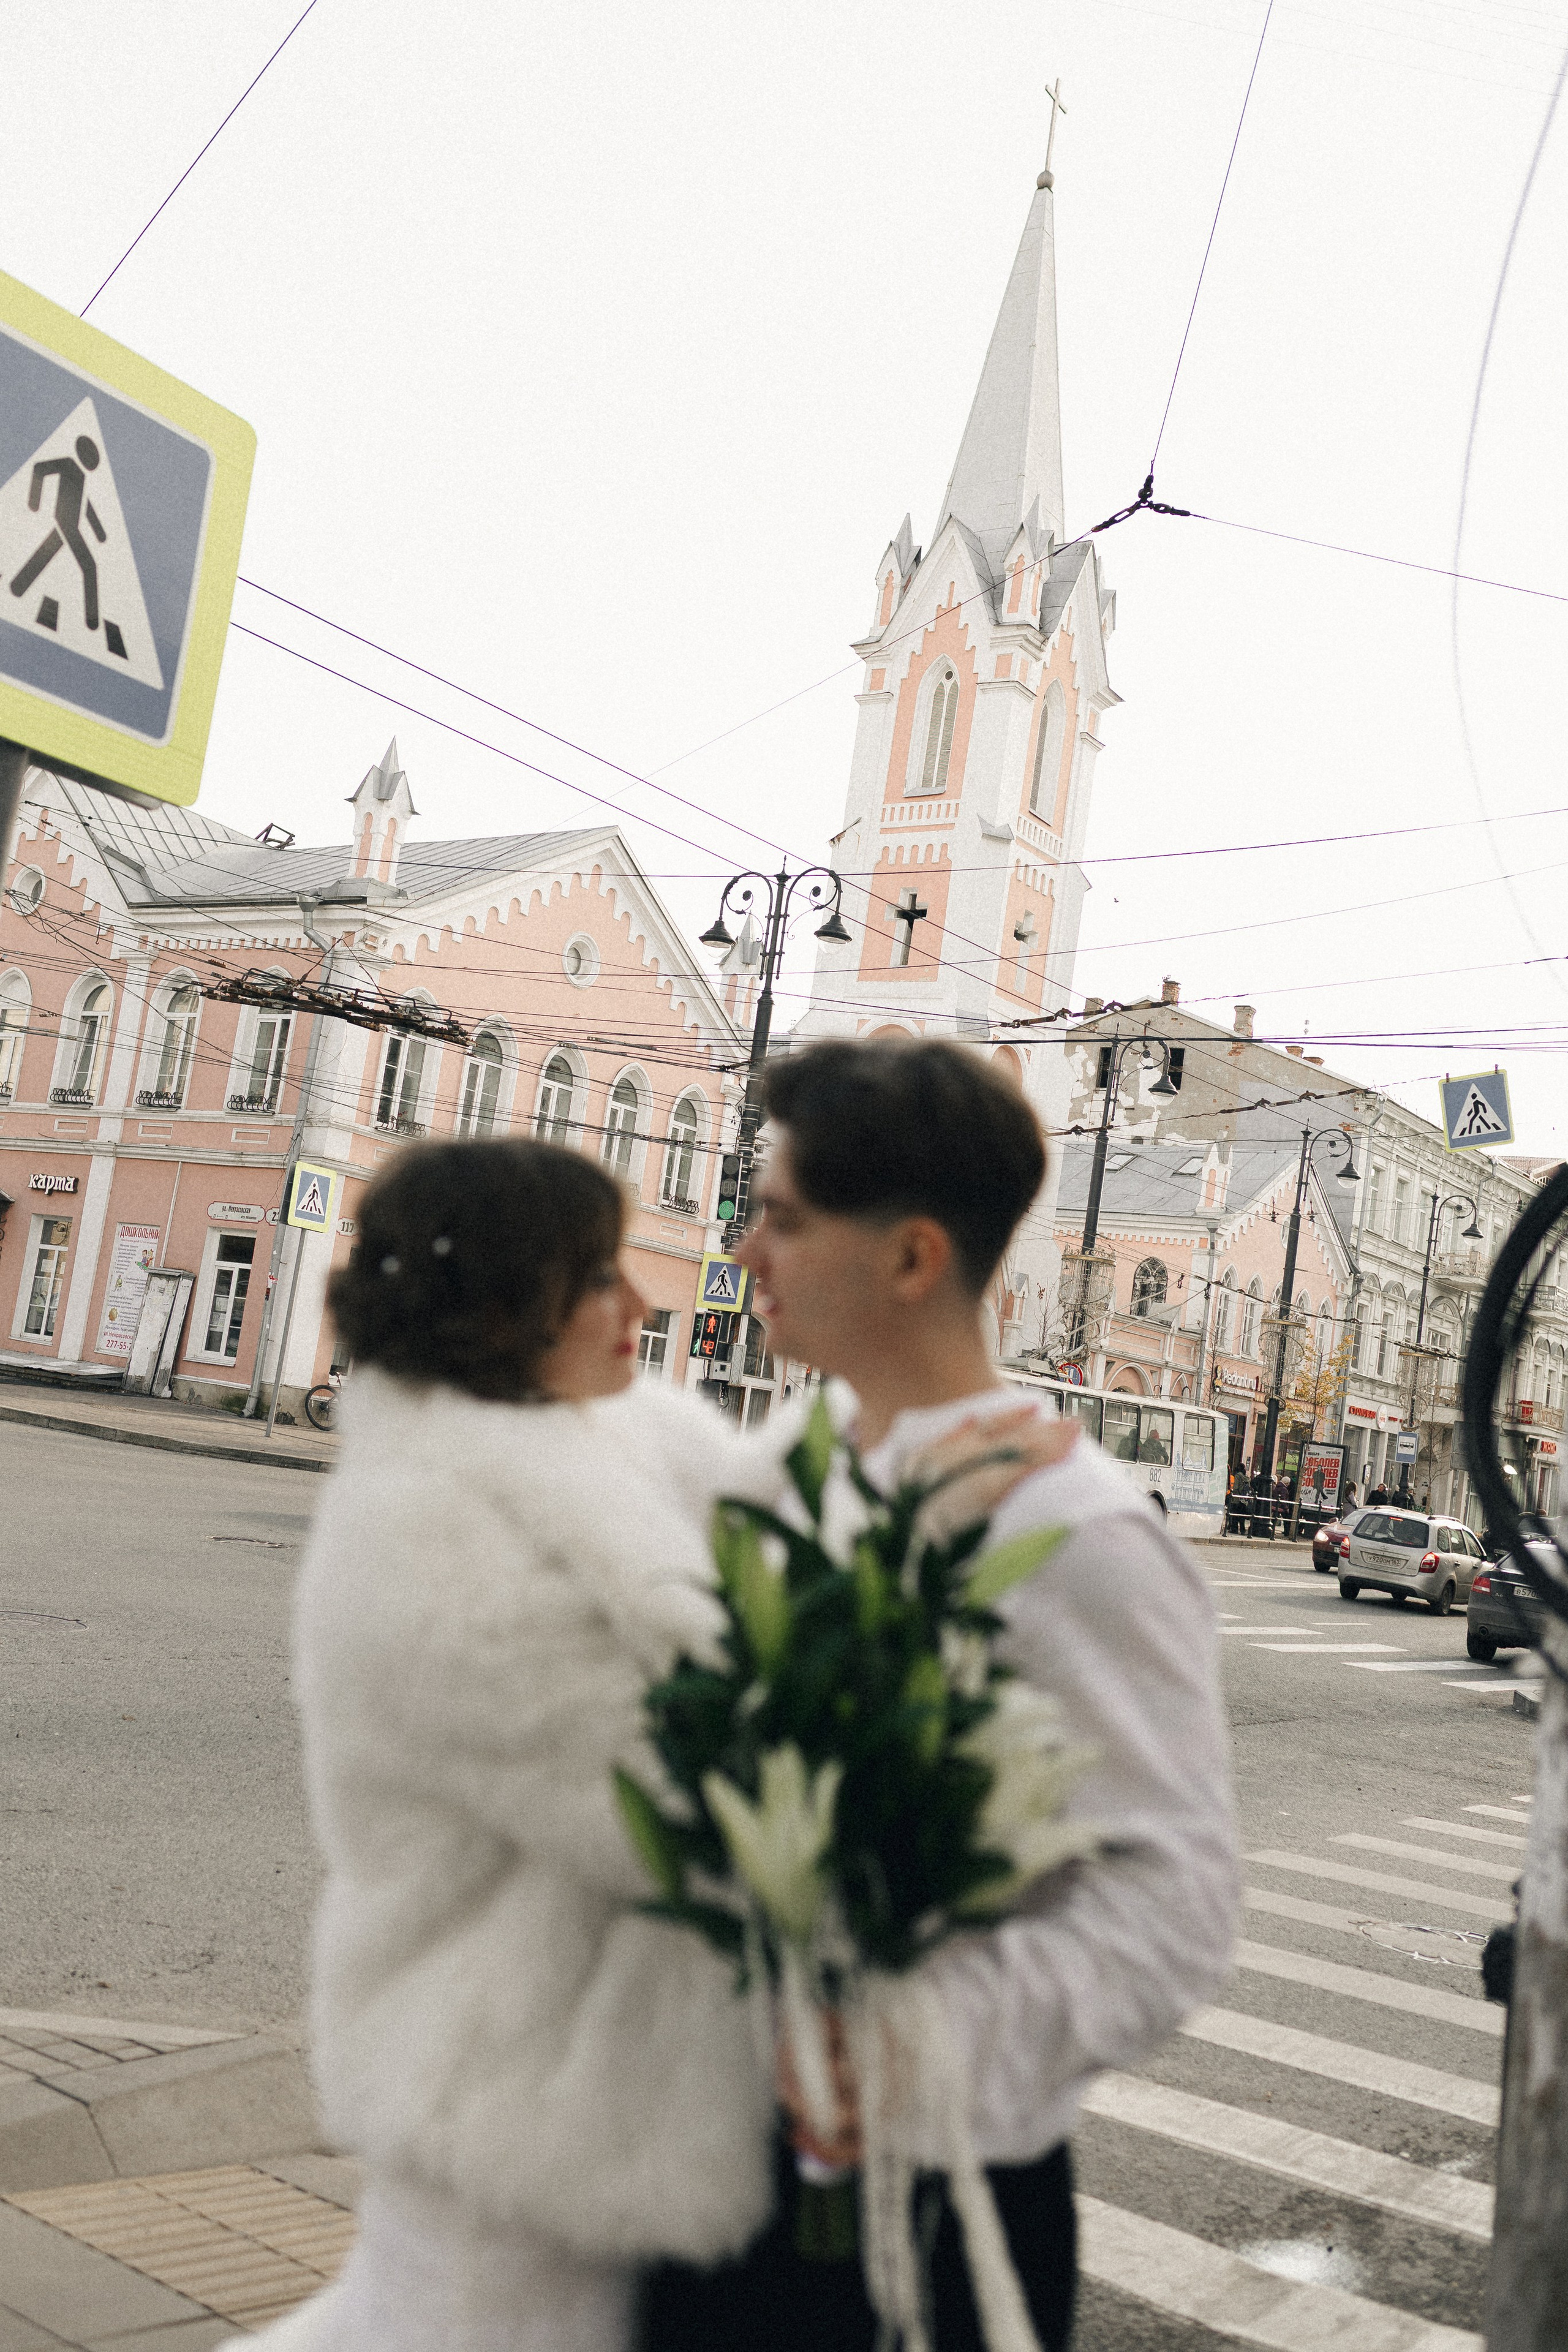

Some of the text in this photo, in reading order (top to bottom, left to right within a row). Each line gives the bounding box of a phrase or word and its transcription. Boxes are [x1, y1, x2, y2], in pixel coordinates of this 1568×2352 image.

[28, 1174, 76, 1195] карта
[228, 1205, 251, 1213] Некрасовская
[120, 1226, 159, 1239] ДОШКОЛЬНИК
[341, 1221, 355, 1233] 117
[106, 1340, 132, 1351] 277-55-7
[1349, 1406, 1376, 1419] СТОЛОВАЯ
[1150, 1468, 1161, 1482] 882
[1303, 1467, 1338, 1479] СОБЛЕВ
